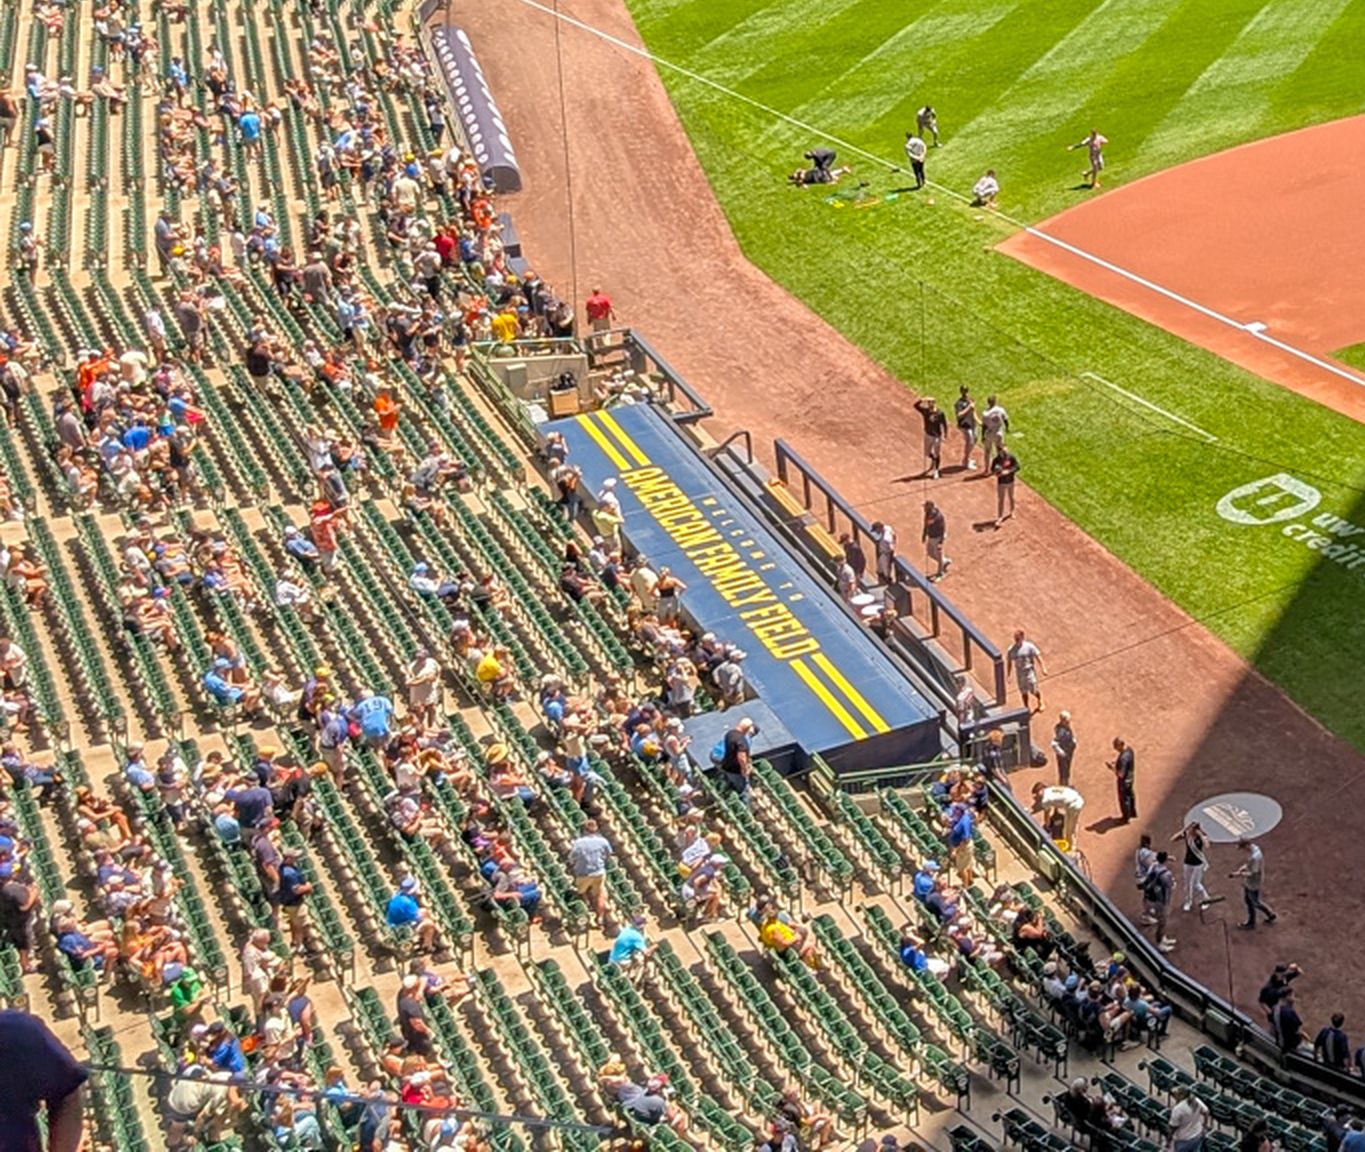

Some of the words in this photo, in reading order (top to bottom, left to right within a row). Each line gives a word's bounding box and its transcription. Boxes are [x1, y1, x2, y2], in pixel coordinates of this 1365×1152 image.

[620, 465, 723, 555] AMERICAN
[691, 541, 776, 610] FAMILY
[738, 601, 822, 662] FIELD
